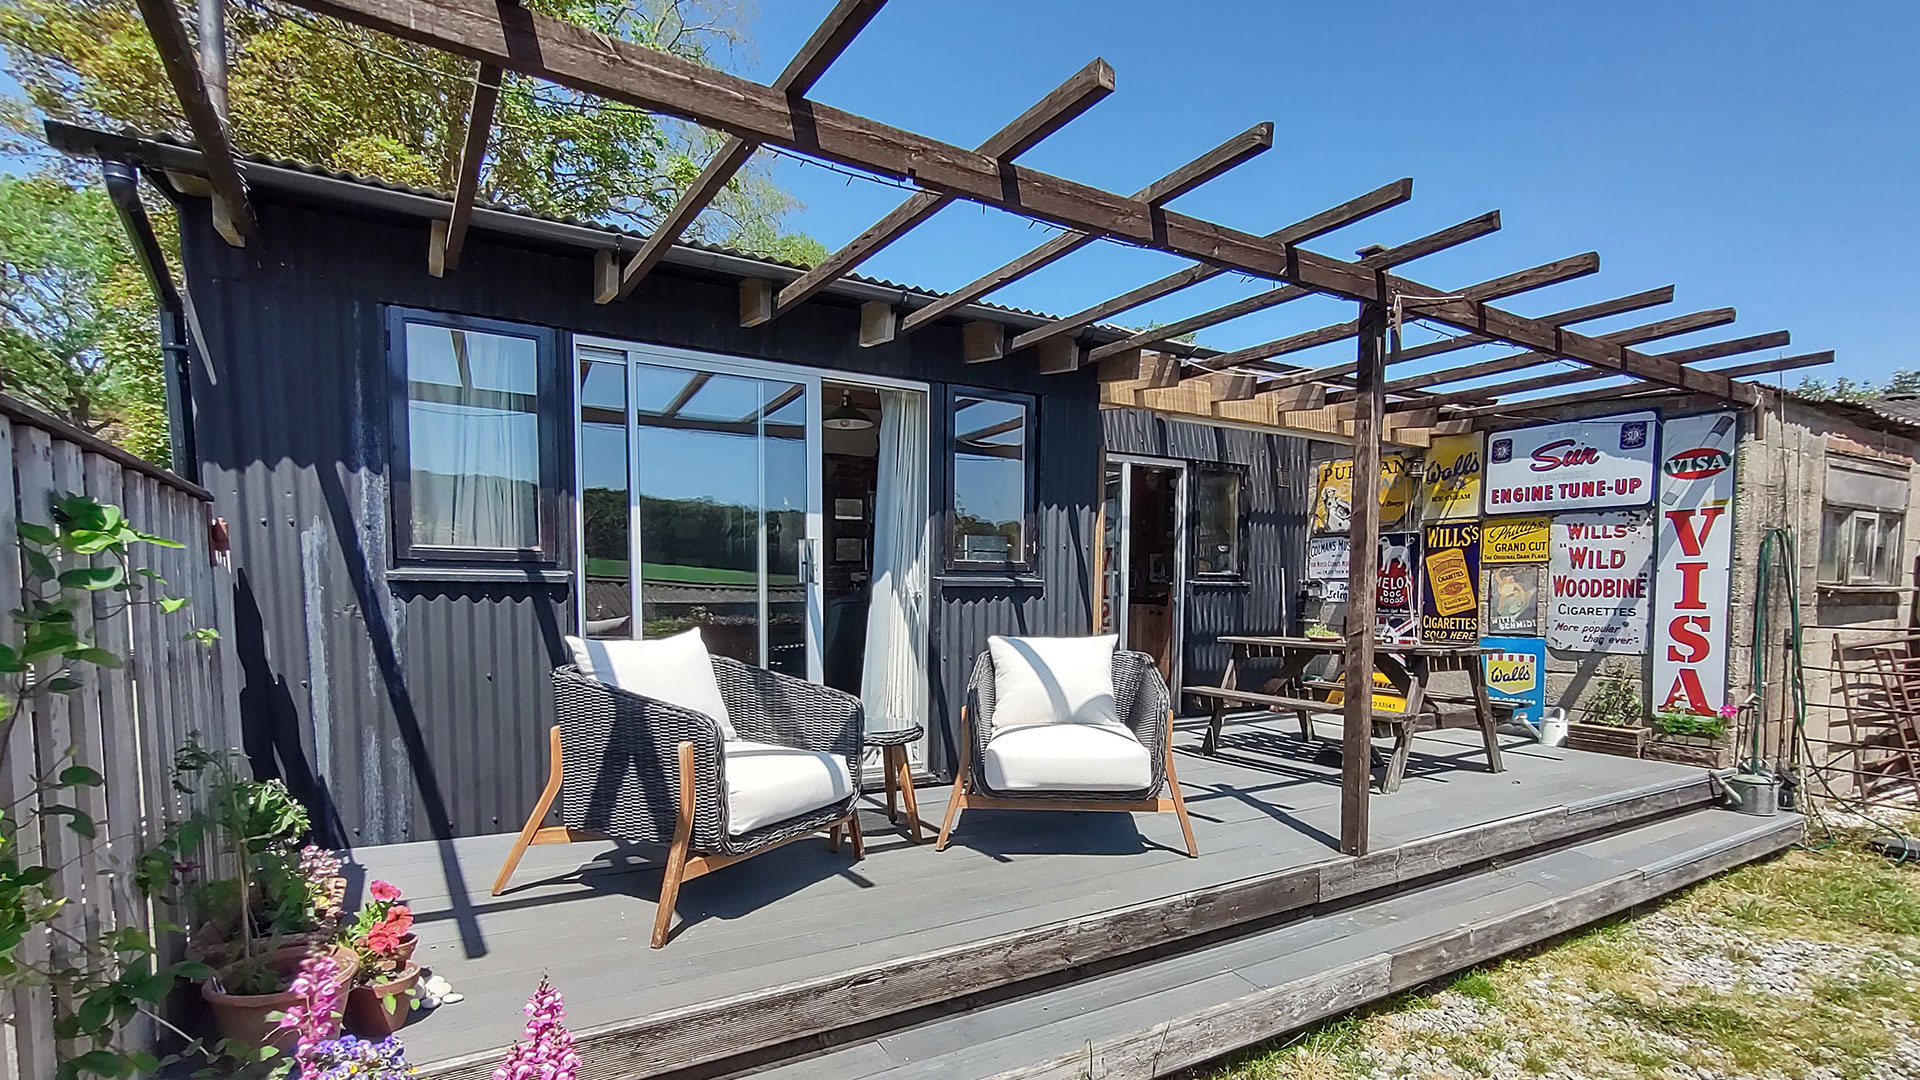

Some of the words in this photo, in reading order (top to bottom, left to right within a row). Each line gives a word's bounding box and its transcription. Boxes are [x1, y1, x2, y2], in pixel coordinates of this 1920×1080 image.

[1530, 438, 1600, 472] Sun
[1667, 454, 1728, 474] VISA
[1491, 485, 1553, 504] ENGINE
[1559, 478, 1642, 499] TUNE-UP
[1495, 542, 1526, 552] GRAND
[1529, 541, 1547, 551] CUT
[1380, 595, 1405, 604] FOODS
[1383, 590, 1402, 598] DOG
[1558, 603, 1637, 617] CIGARETTES
[1657, 506, 1726, 717] VISA
[1423, 615, 1477, 630] CIGARETTES
[1581, 624, 1621, 635] popular
[1424, 629, 1447, 639] SOLD
[1450, 631, 1476, 640] HERE
[1491, 664, 1531, 683] Wall's
